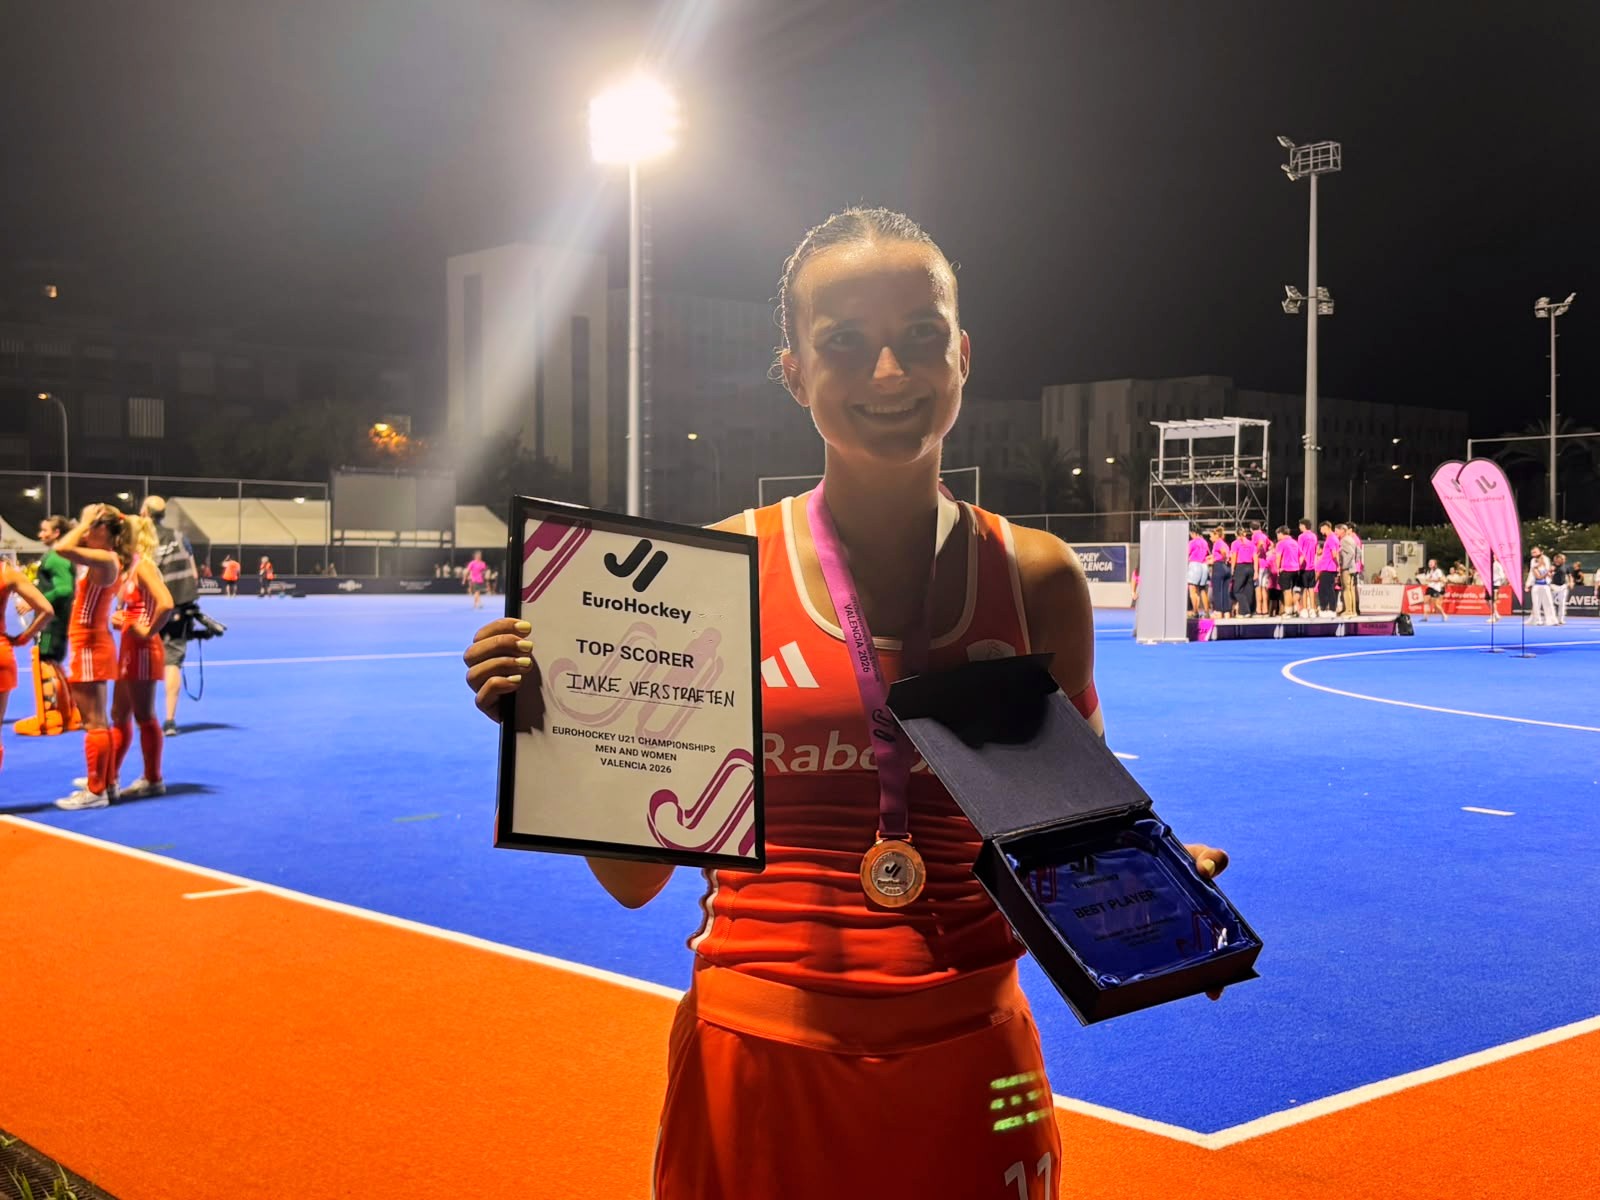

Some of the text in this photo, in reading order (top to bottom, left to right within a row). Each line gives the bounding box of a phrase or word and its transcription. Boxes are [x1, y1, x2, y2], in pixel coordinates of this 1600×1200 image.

[1079, 552, 1100, 562] CKEY
[1082, 561, 1113, 571] LENCIA
[582, 591, 691, 624] EuroHockey
[844, 603, 864, 648] VALENCIA
[858, 650, 871, 673] 2026
[576, 638, 694, 669] TOP SCORER
[566, 673, 735, 707] IMKE VERSTRAETEN
[552, 726, 716, 753] EUROHOCKEY U21 CHAMPIONSHIPS
[595, 744, 677, 762] MEN AND WOMEN
[600, 757, 672, 773] VALENCIA 2026
[1072, 889, 1158, 919] BEST PLAYER
[1004, 1151, 1051, 1200] 11
